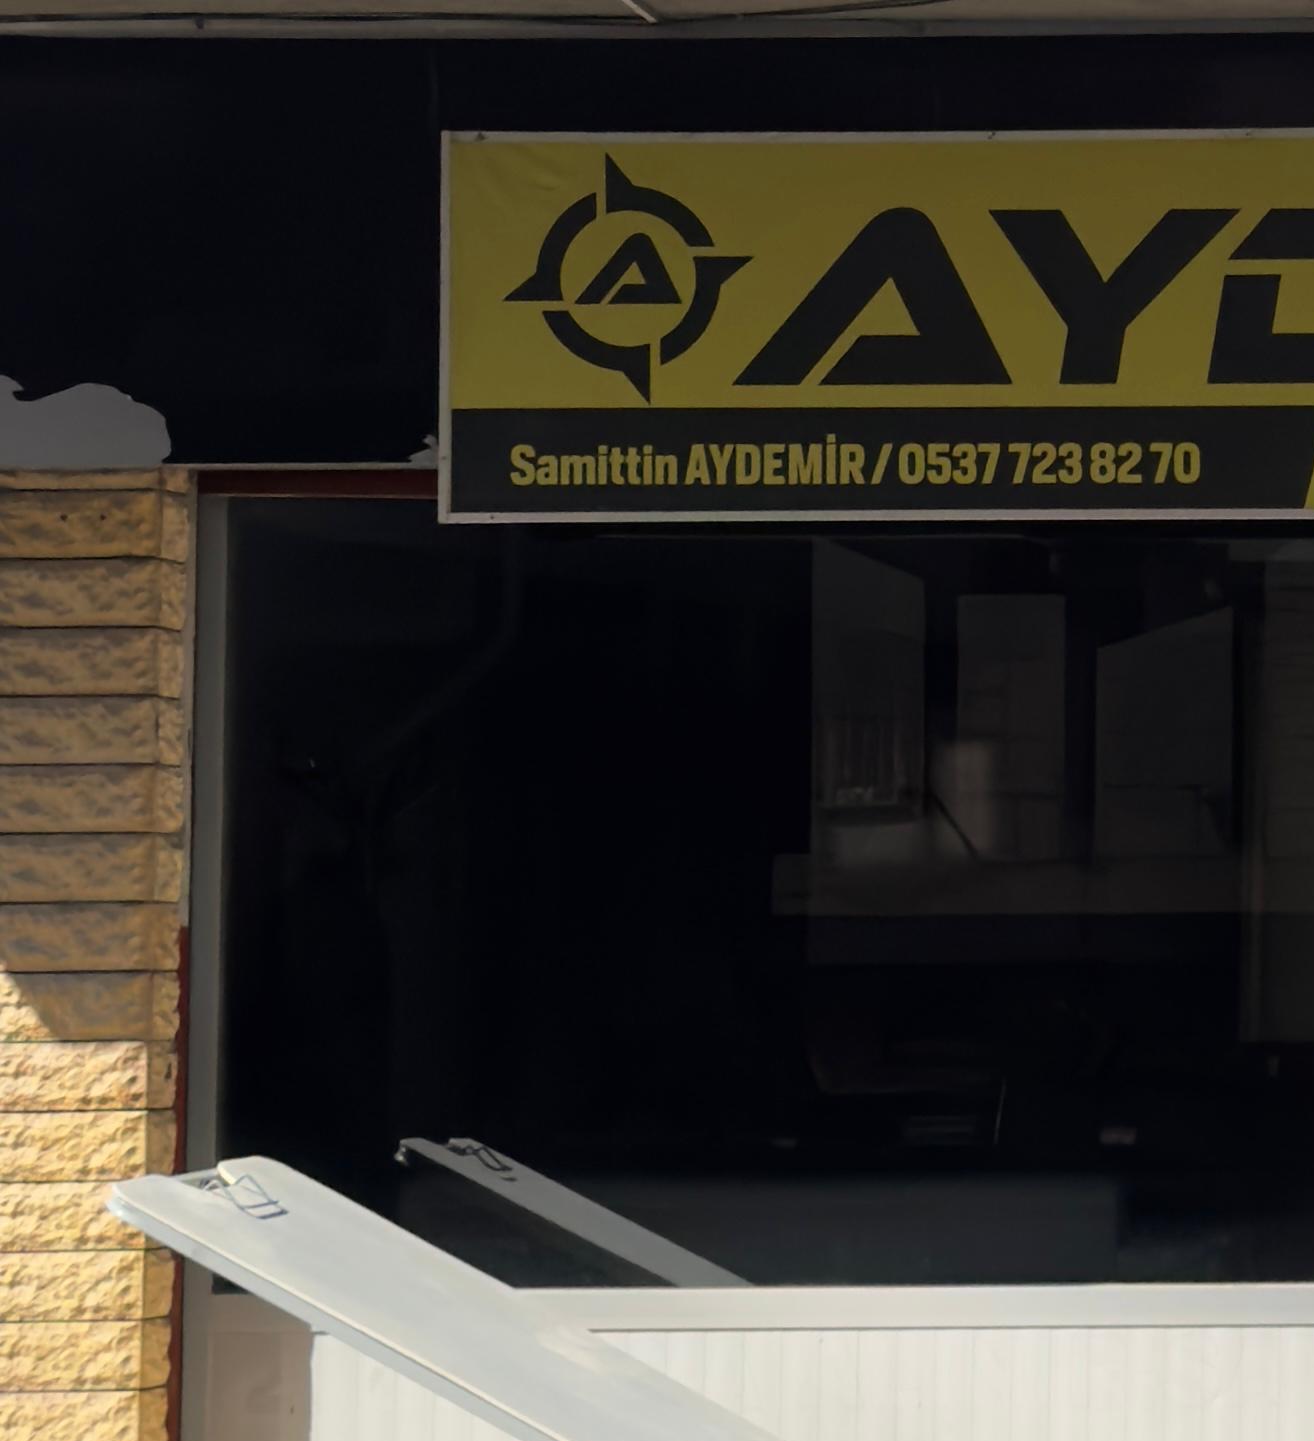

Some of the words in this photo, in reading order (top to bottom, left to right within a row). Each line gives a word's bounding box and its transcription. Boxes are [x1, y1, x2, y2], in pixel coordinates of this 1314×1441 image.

[509, 443, 677, 486] Samittin
[685, 433, 865, 485] AYDEMİR
[898, 442, 999, 483] 0537
[1009, 442, 1082, 483] 723
[1090, 442, 1142, 483] 82
[1150, 442, 1200, 483] 70
